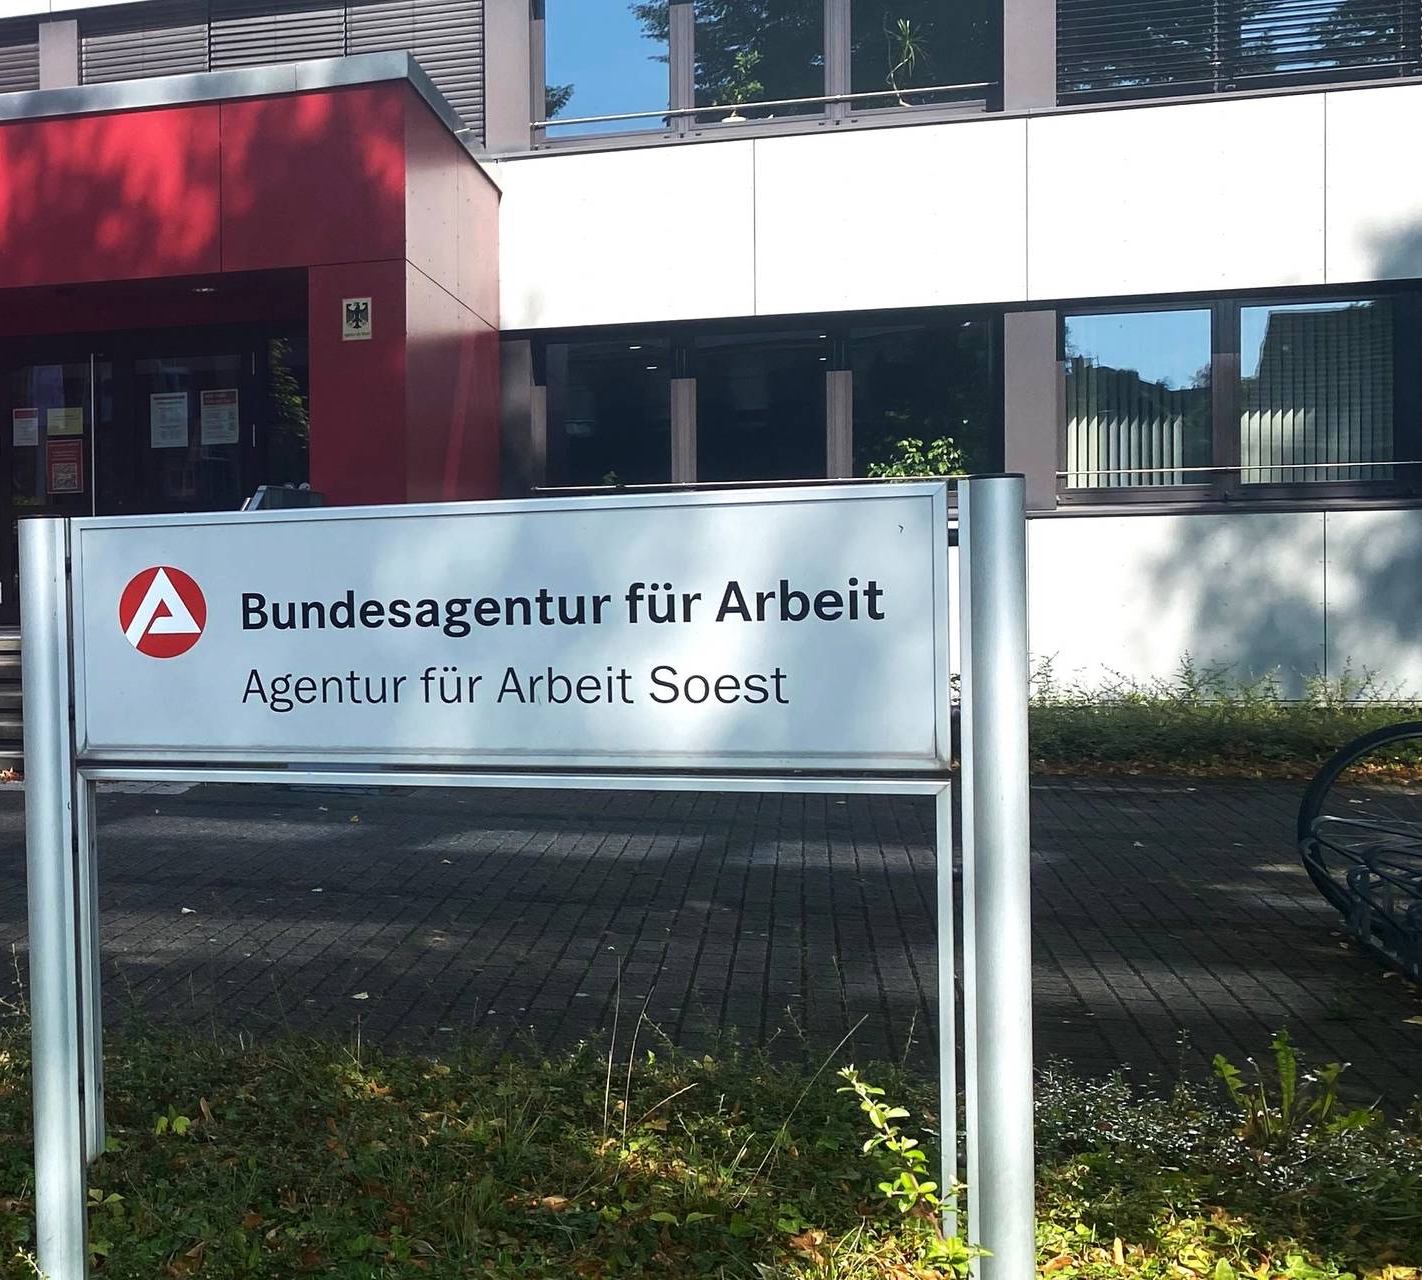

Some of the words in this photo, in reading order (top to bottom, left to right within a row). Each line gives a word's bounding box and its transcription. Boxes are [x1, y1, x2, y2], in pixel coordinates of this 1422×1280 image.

[241, 588, 612, 638] Bundesagentur
[624, 582, 702, 624] für
[715, 577, 885, 623] Arbeit
[241, 668, 407, 713] Agentur
[419, 666, 483, 704] für
[496, 666, 634, 704] Arbeit
[649, 665, 790, 704] Soest
